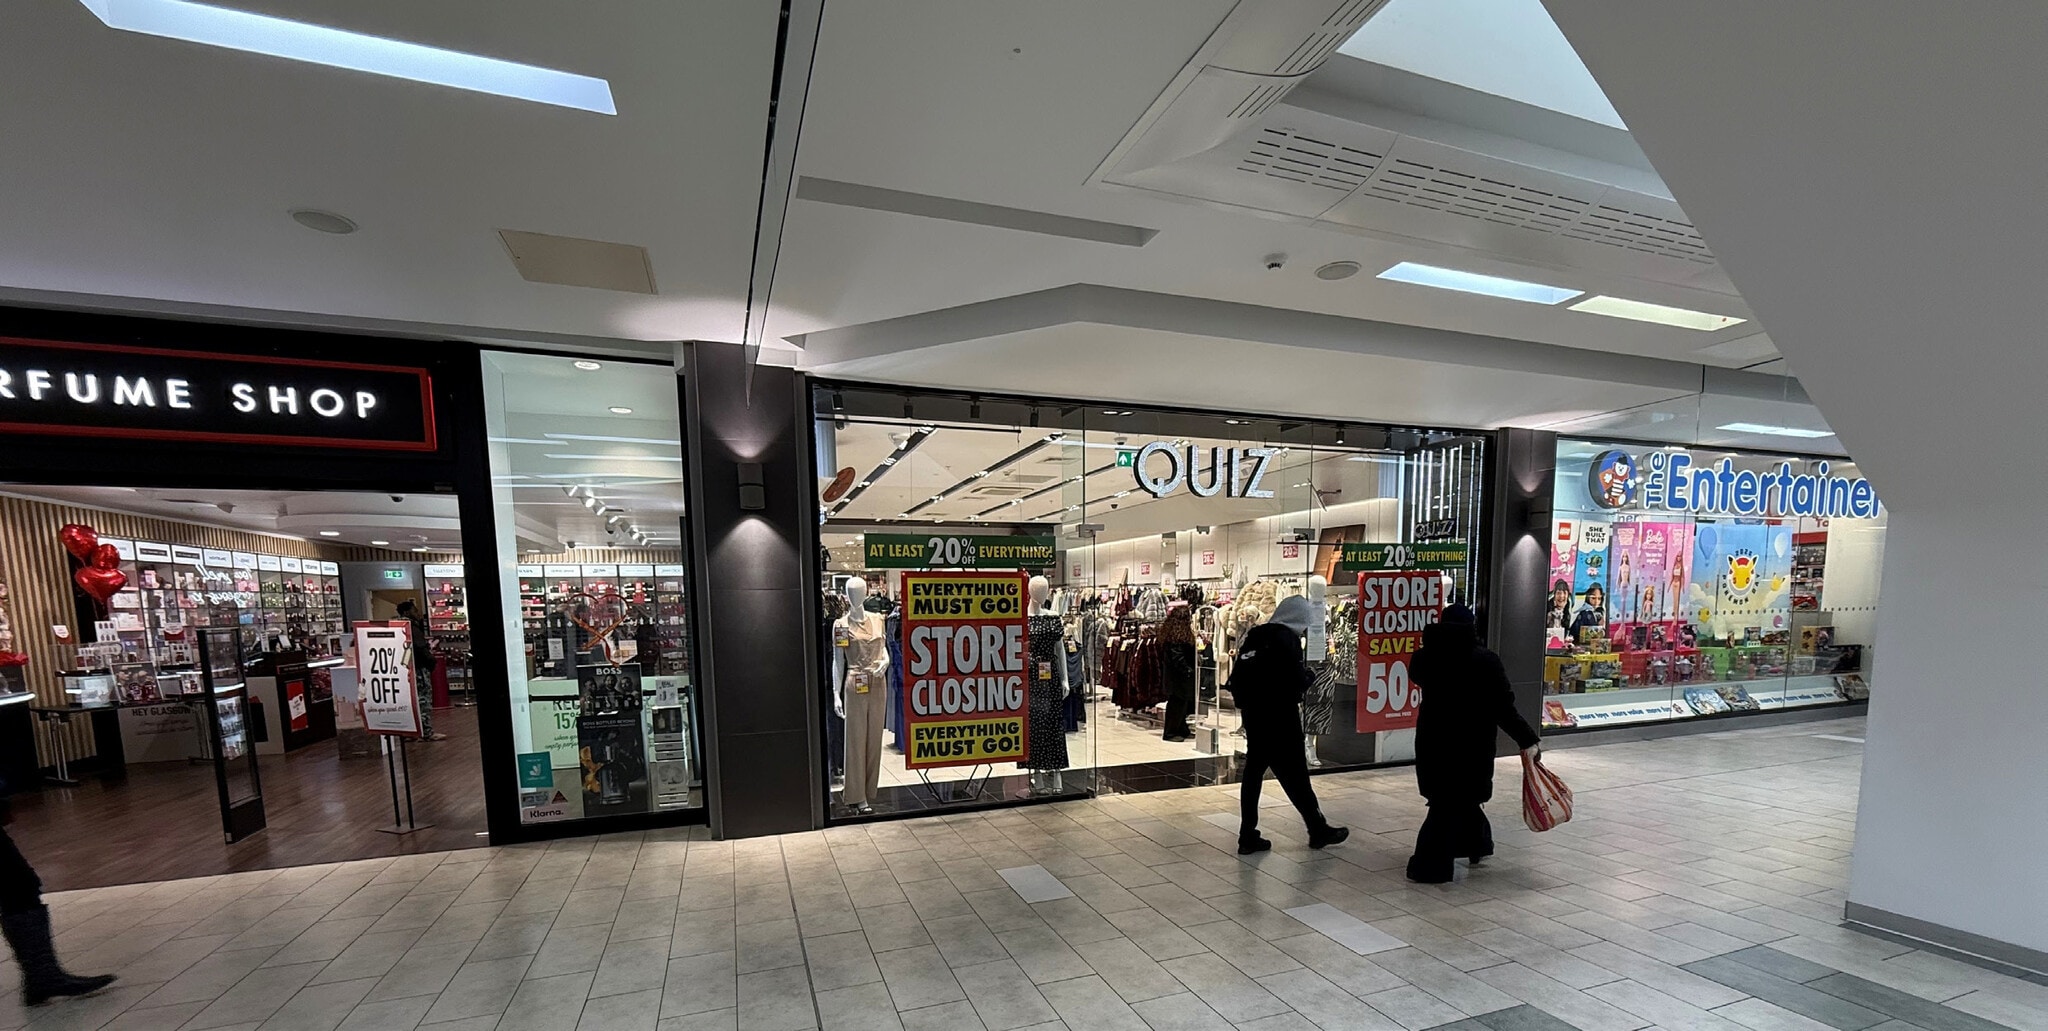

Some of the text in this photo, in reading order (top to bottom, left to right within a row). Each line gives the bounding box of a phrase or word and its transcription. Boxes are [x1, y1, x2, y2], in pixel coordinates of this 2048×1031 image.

[233, 383, 376, 418] SHOP
[1135, 441, 1275, 498] QUIZ
[1644, 452, 1665, 508] The
[869, 537, 1053, 566] AT LEAST 20% OFF EVERYTHING!
[1346, 551, 1355, 562] AT
[1358, 551, 1382, 562] LEAST
[1384, 545, 1415, 567] 20%
[1417, 551, 1466, 561] EVERYTHING!
[911, 583, 1019, 596] EVERYTHING
[1363, 577, 1440, 609] STORE
[913, 597, 1019, 615] MUST GO!
[910, 625, 1023, 676] STORE
[1369, 637, 1415, 655] SAVE
[369, 647, 399, 675] 20%
[371, 677, 400, 704] OFF
[911, 675, 1024, 716] CLOSING
[132, 708, 148, 716] HEY
[915, 722, 1020, 741] EVERYTHING
[916, 735, 1020, 758] MUST GO!
